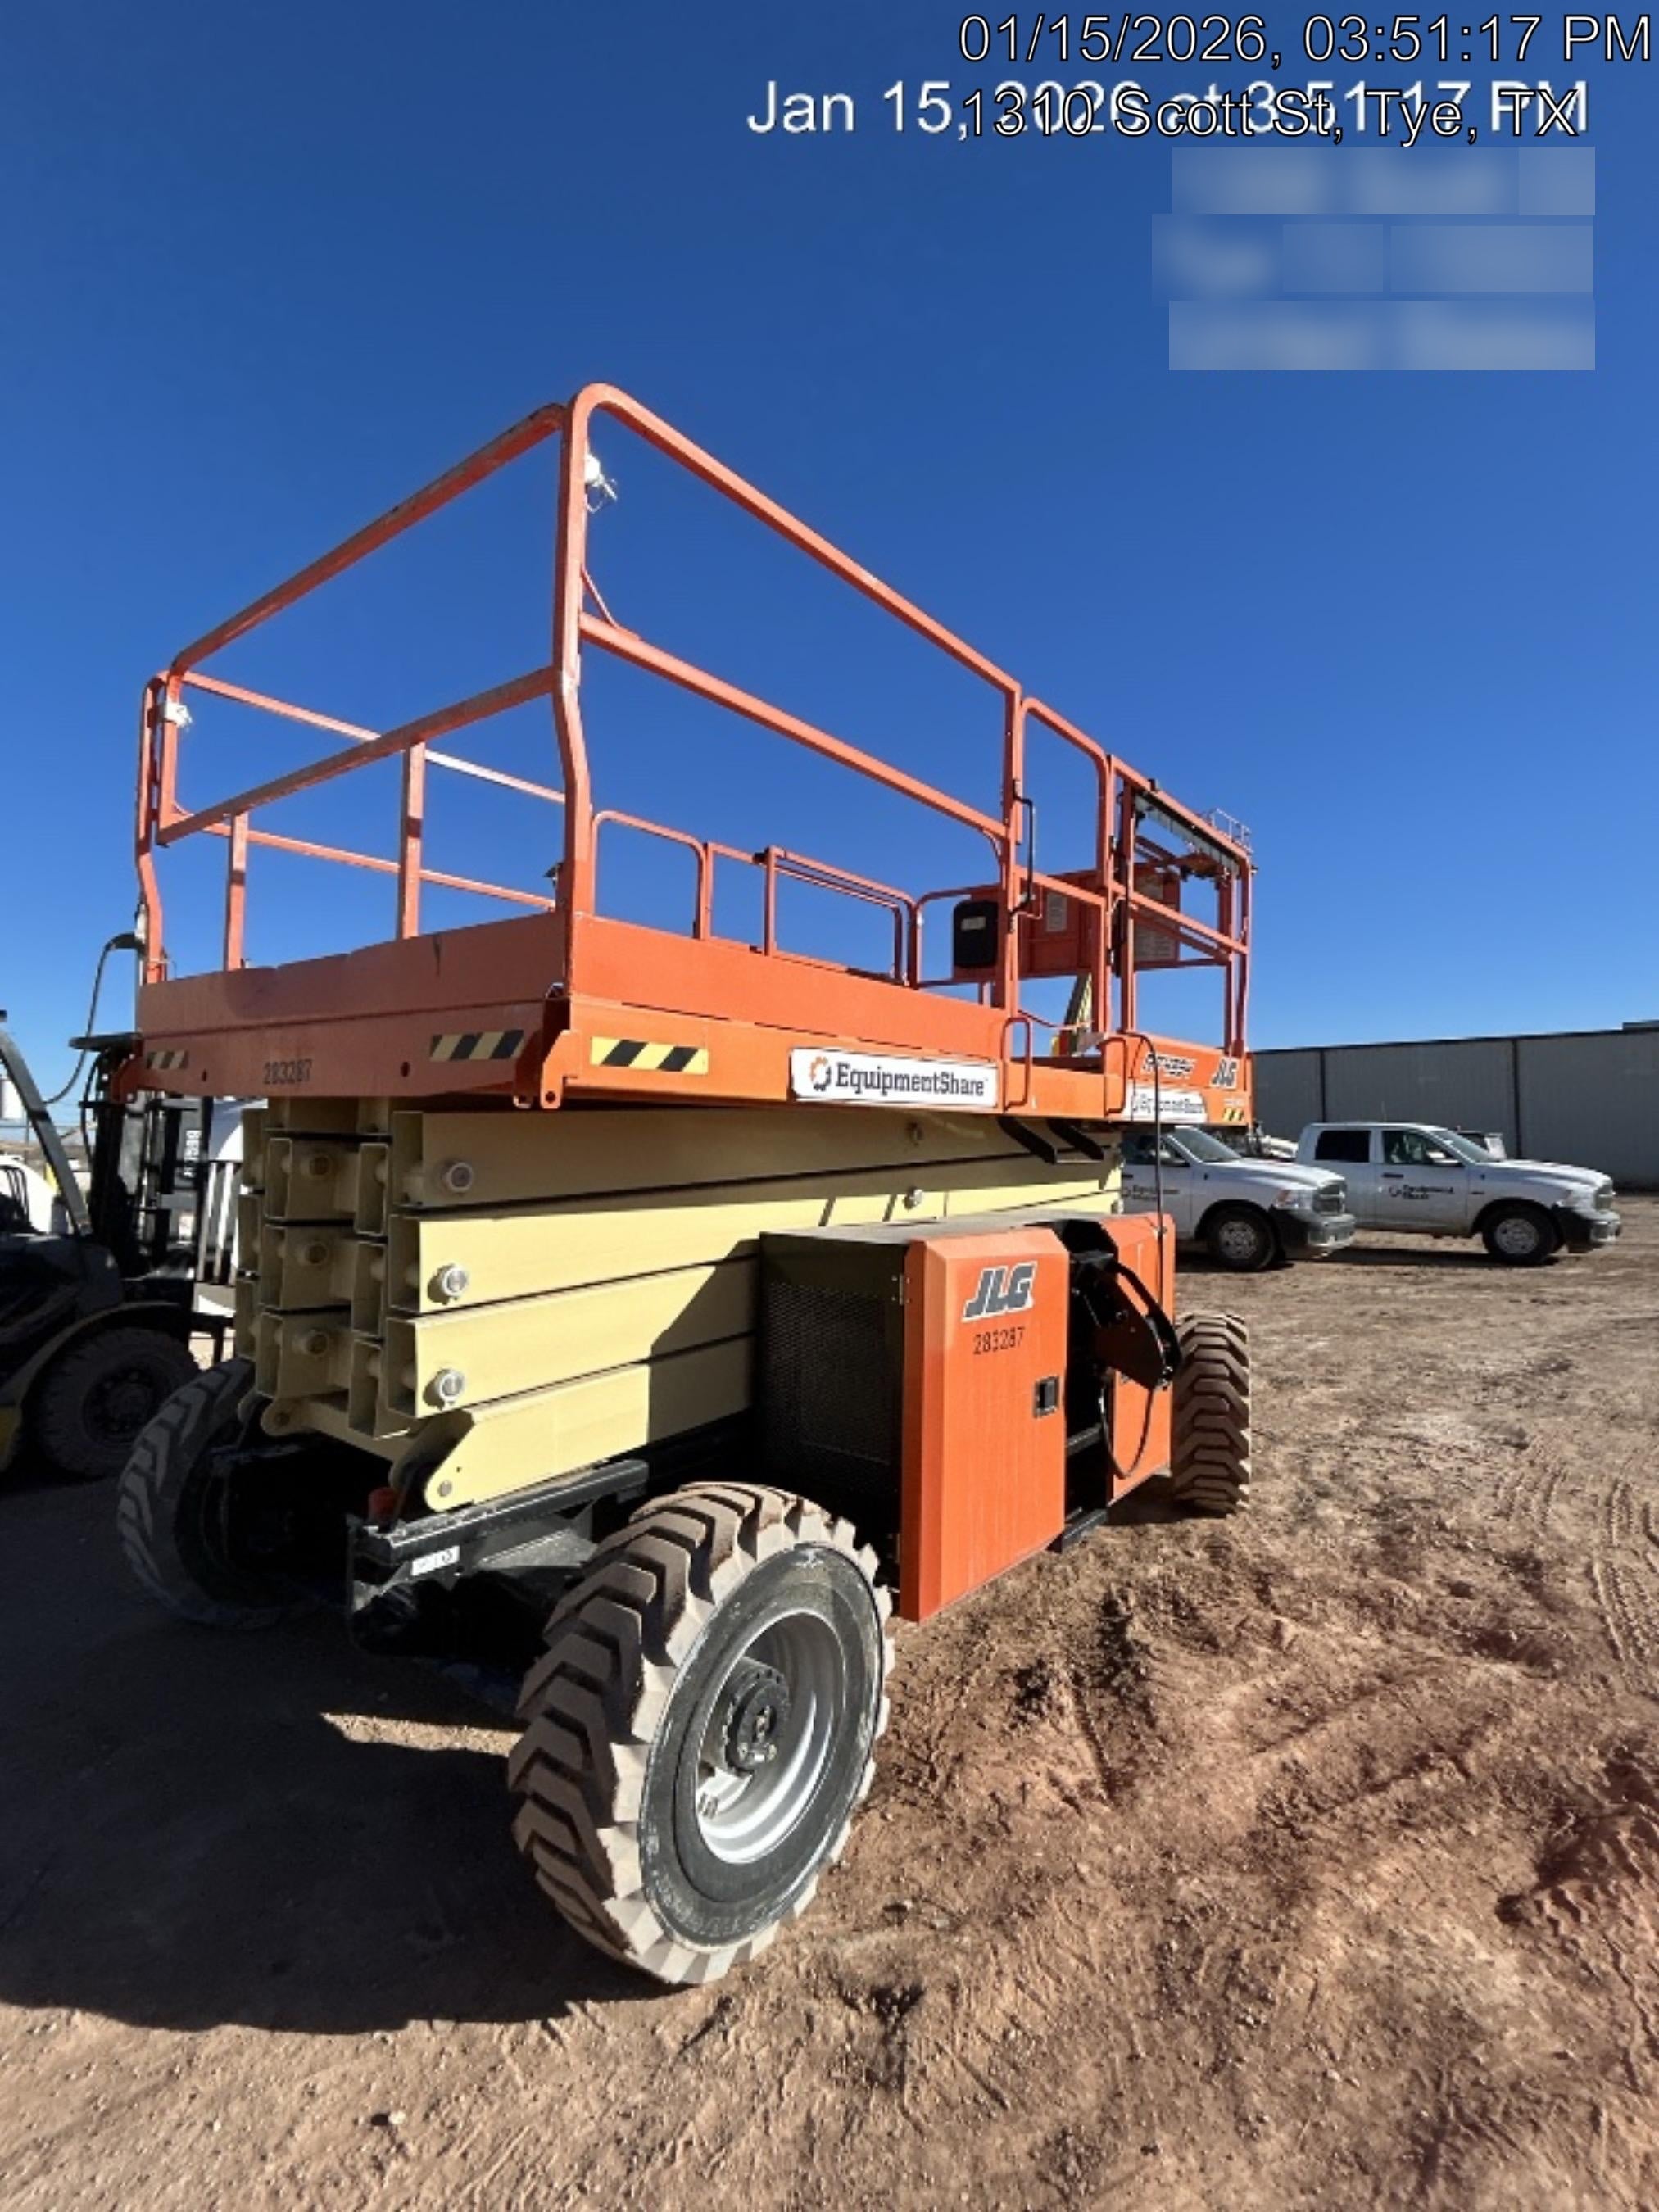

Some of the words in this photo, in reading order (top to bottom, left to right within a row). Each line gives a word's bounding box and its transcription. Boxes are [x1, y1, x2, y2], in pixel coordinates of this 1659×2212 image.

[835, 1062, 985, 1096] EquipmentShare
[962, 1262, 1036, 1321] JLG
[972, 1326, 1025, 1355] 283287
